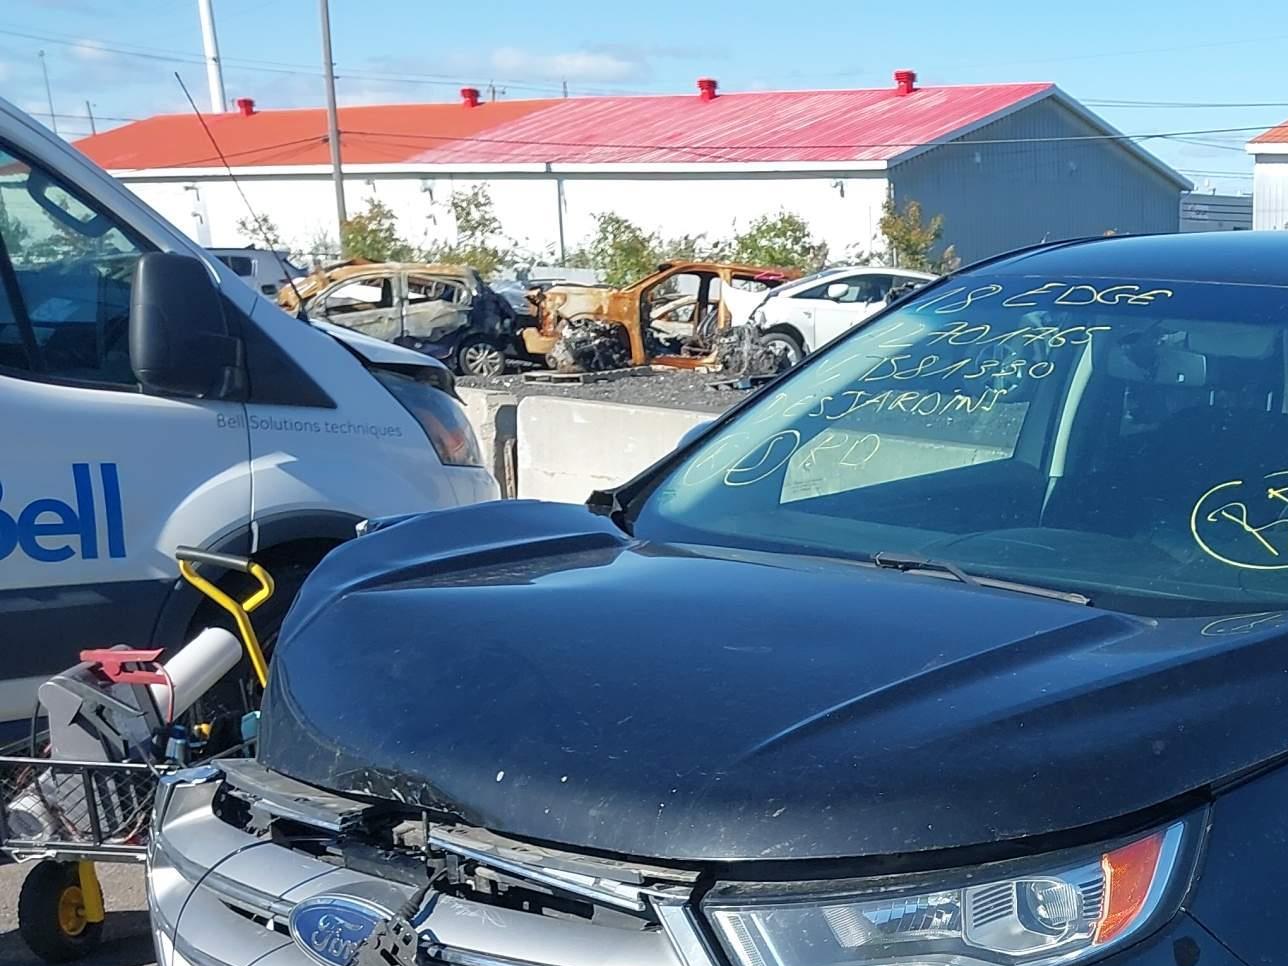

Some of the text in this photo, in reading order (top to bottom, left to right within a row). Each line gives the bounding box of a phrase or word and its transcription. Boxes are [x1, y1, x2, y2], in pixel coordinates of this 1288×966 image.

[916, 283, 1173, 314] 18 EDGE
[216, 412, 403, 440] Bell Solutions techniques
[0, 463, 127, 563] ell
